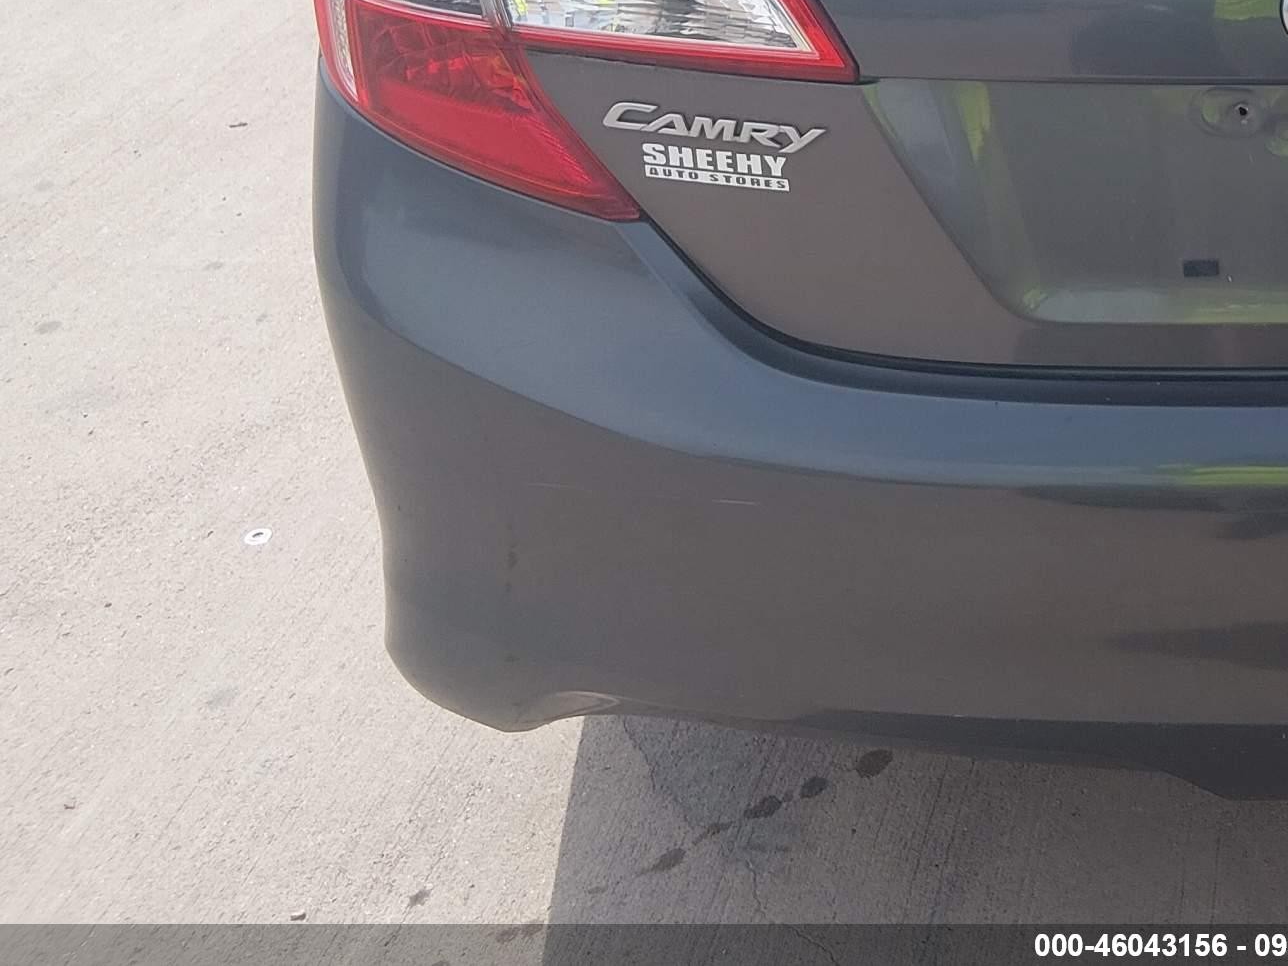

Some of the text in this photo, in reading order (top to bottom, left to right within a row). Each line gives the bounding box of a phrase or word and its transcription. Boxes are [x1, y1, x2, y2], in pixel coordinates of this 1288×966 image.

[602, 101, 826, 154] CAMRY
[642, 142, 787, 177] SHEEHY
[649, 166, 787, 190] AUTO STORES
